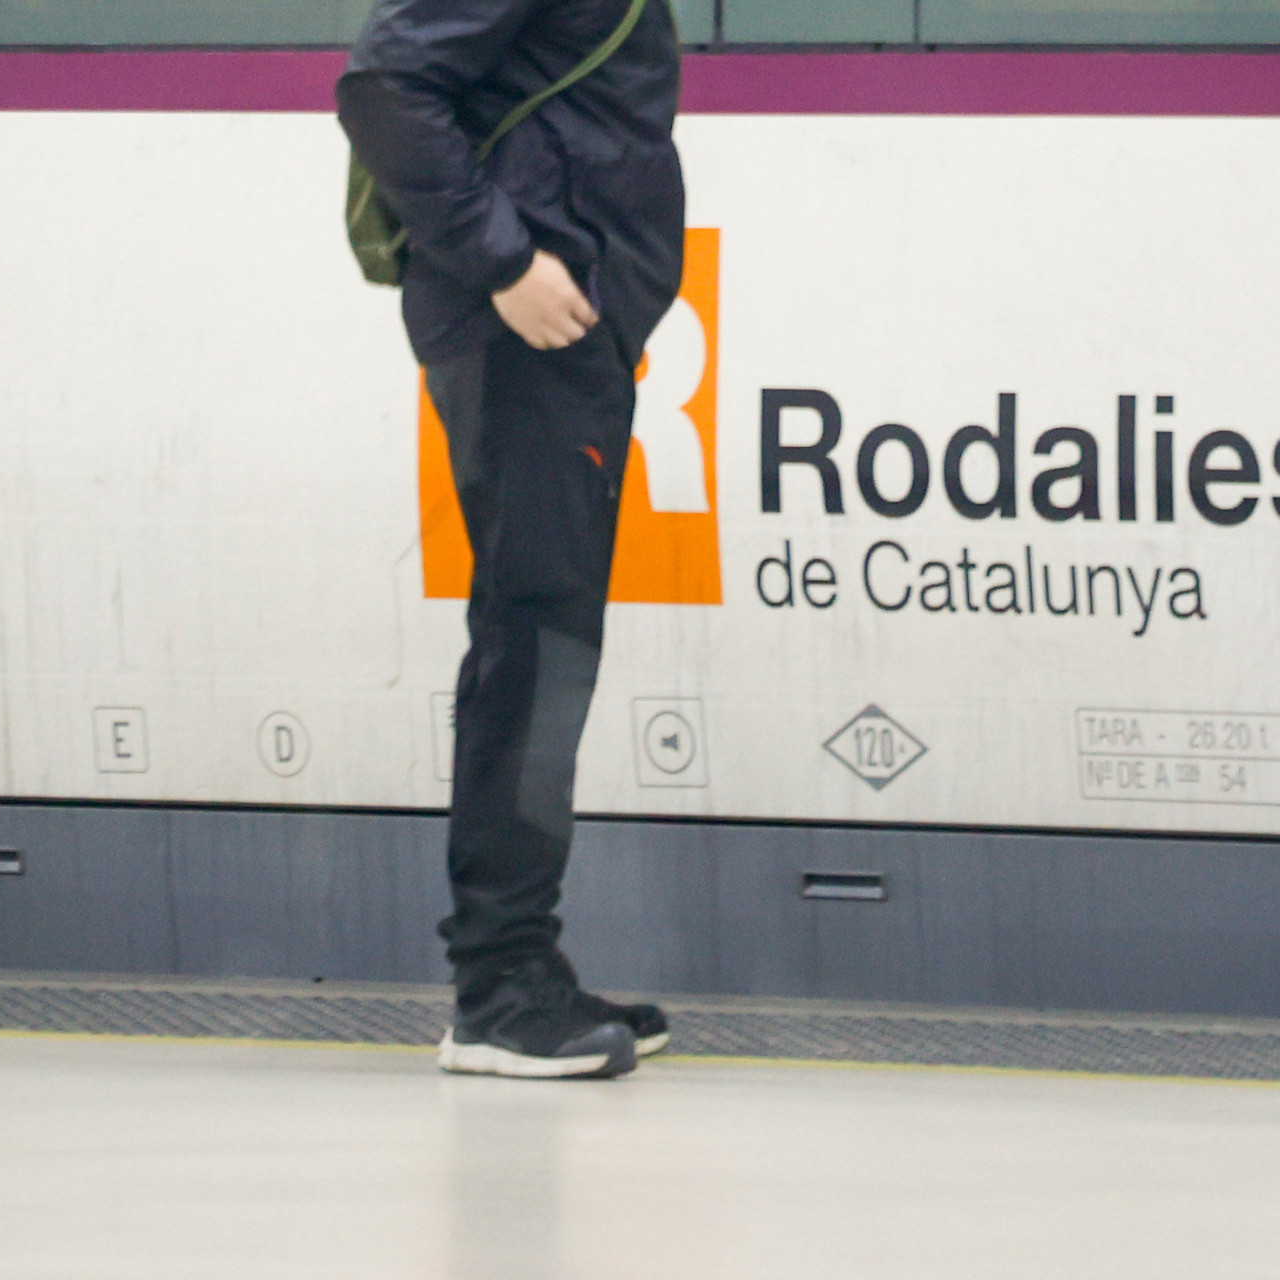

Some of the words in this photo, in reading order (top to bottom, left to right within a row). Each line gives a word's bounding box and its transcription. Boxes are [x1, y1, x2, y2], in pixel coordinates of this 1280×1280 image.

[754, 539, 838, 610] de
[862, 540, 1208, 638] Catalunya
[112, 720, 133, 760] E
[275, 724, 296, 764] D
